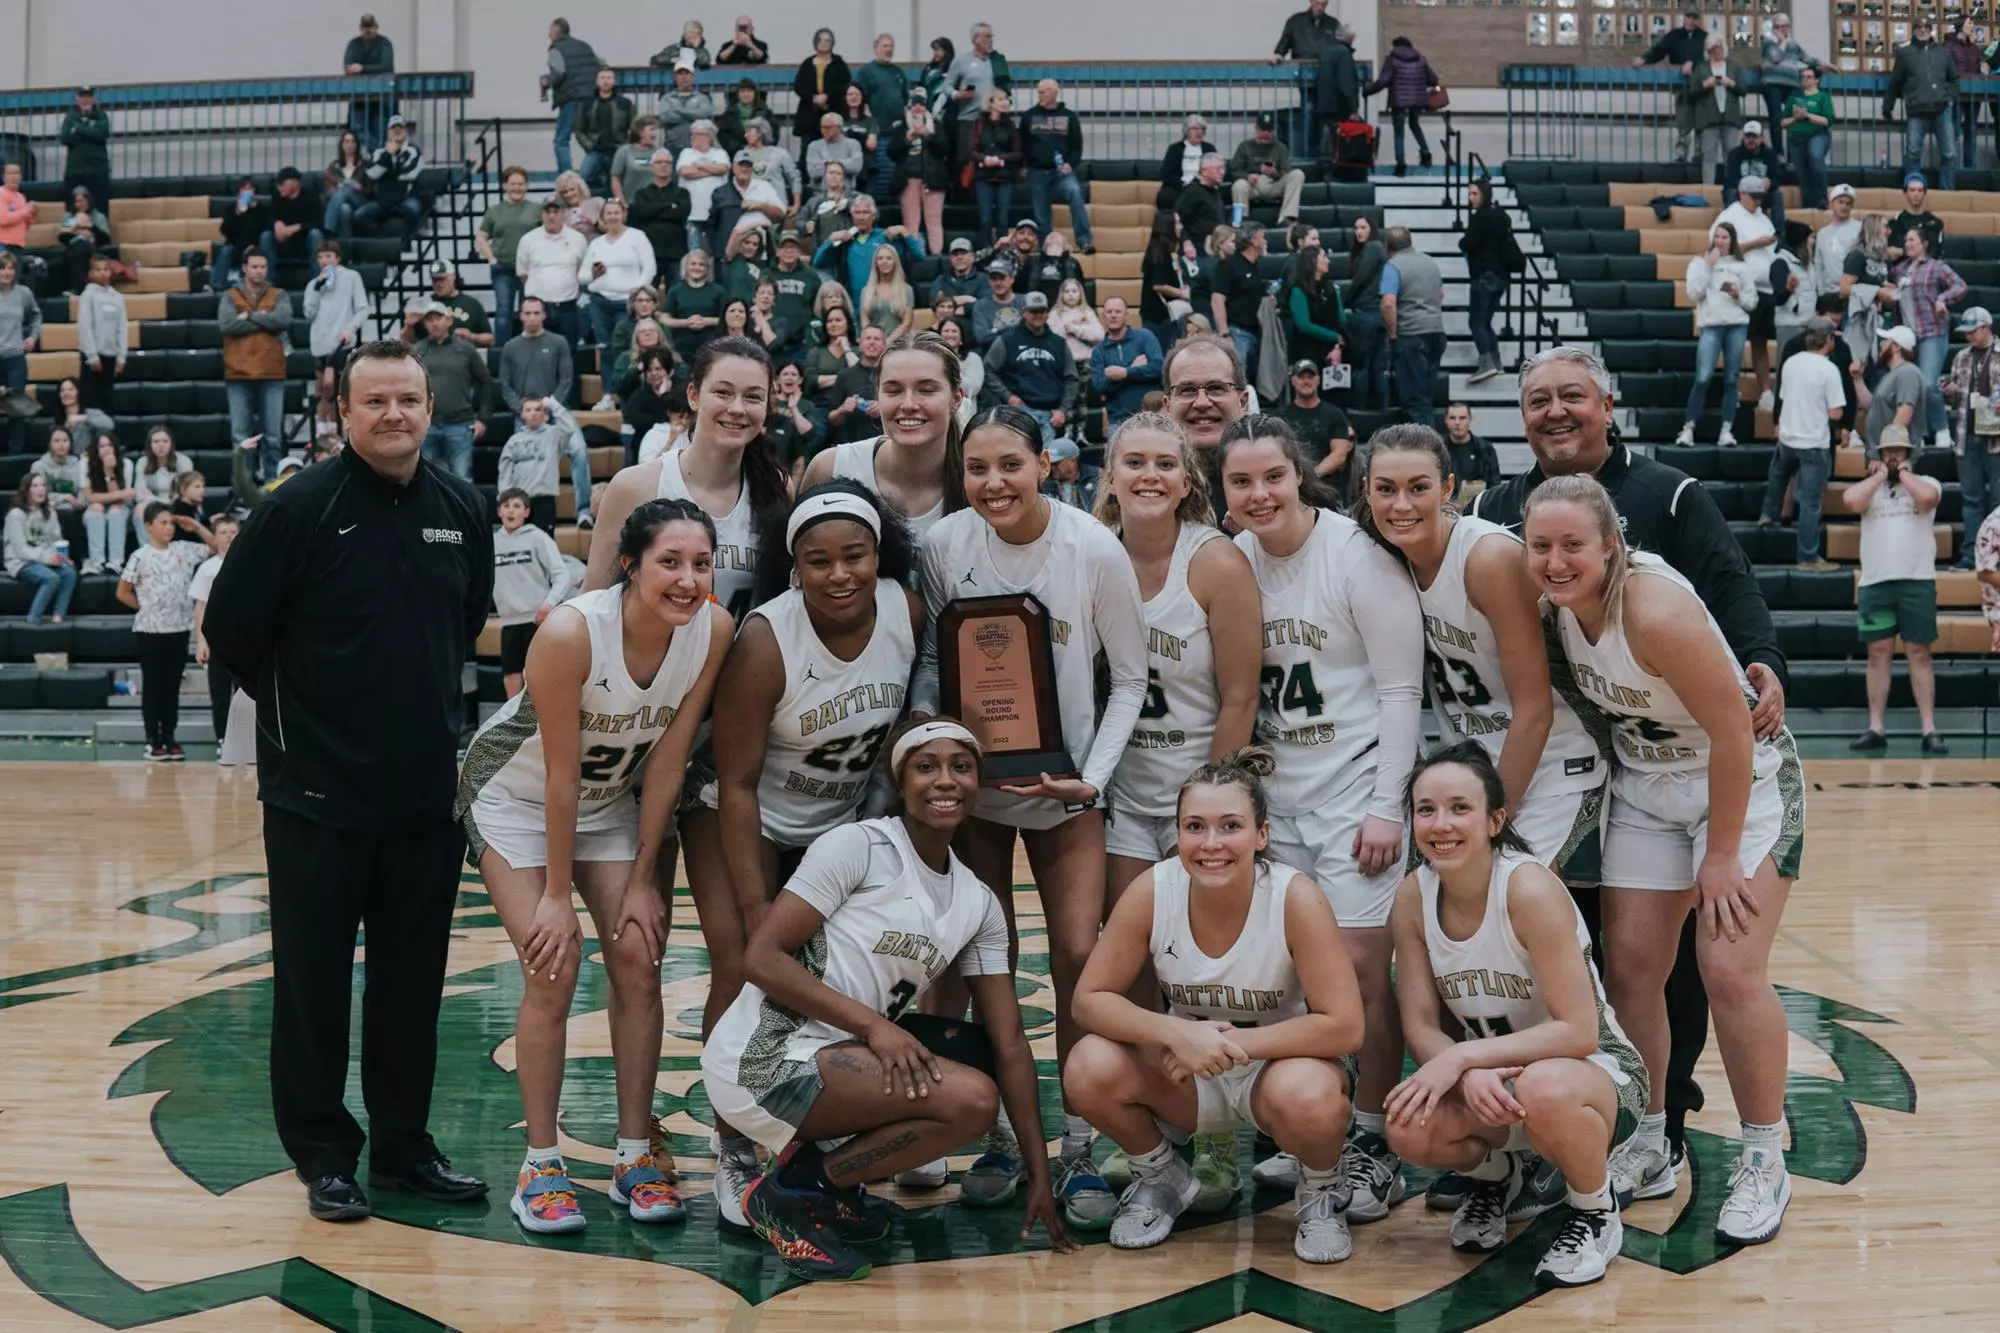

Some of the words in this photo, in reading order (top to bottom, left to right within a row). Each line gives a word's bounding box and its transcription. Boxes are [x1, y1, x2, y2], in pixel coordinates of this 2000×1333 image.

[435, 529, 463, 540] ROCKY
[981, 698, 1015, 707] OPENING
[985, 706, 1012, 714] ROUND
[980, 714, 1019, 722] CHAMPION
[1128, 730, 1186, 748] ARS
[804, 722, 892, 772] 23
[784, 771, 871, 801] BEAR
